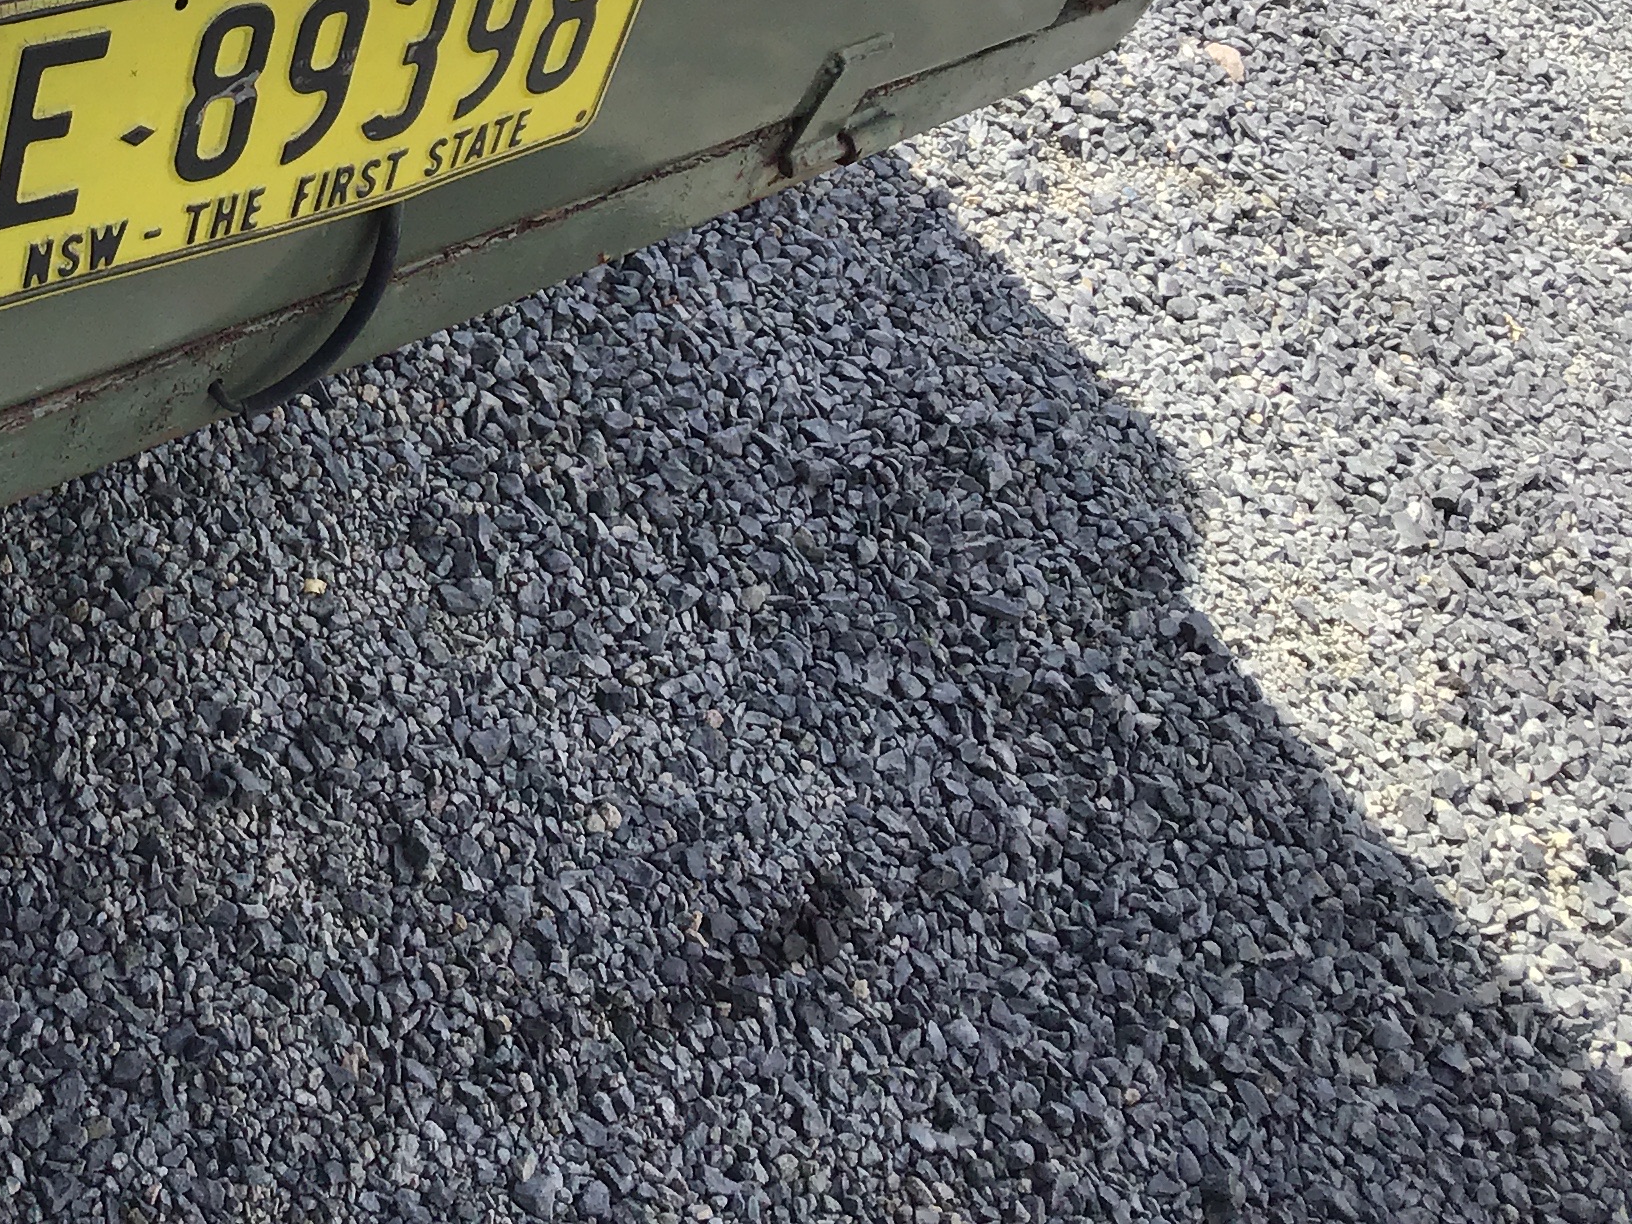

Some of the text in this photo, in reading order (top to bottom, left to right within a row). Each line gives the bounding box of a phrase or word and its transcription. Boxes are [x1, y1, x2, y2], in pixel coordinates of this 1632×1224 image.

[21, 220, 128, 289] NSW
[186, 186, 265, 245] THE
[290, 148, 407, 219] FIRST
[423, 108, 532, 176] STATE
